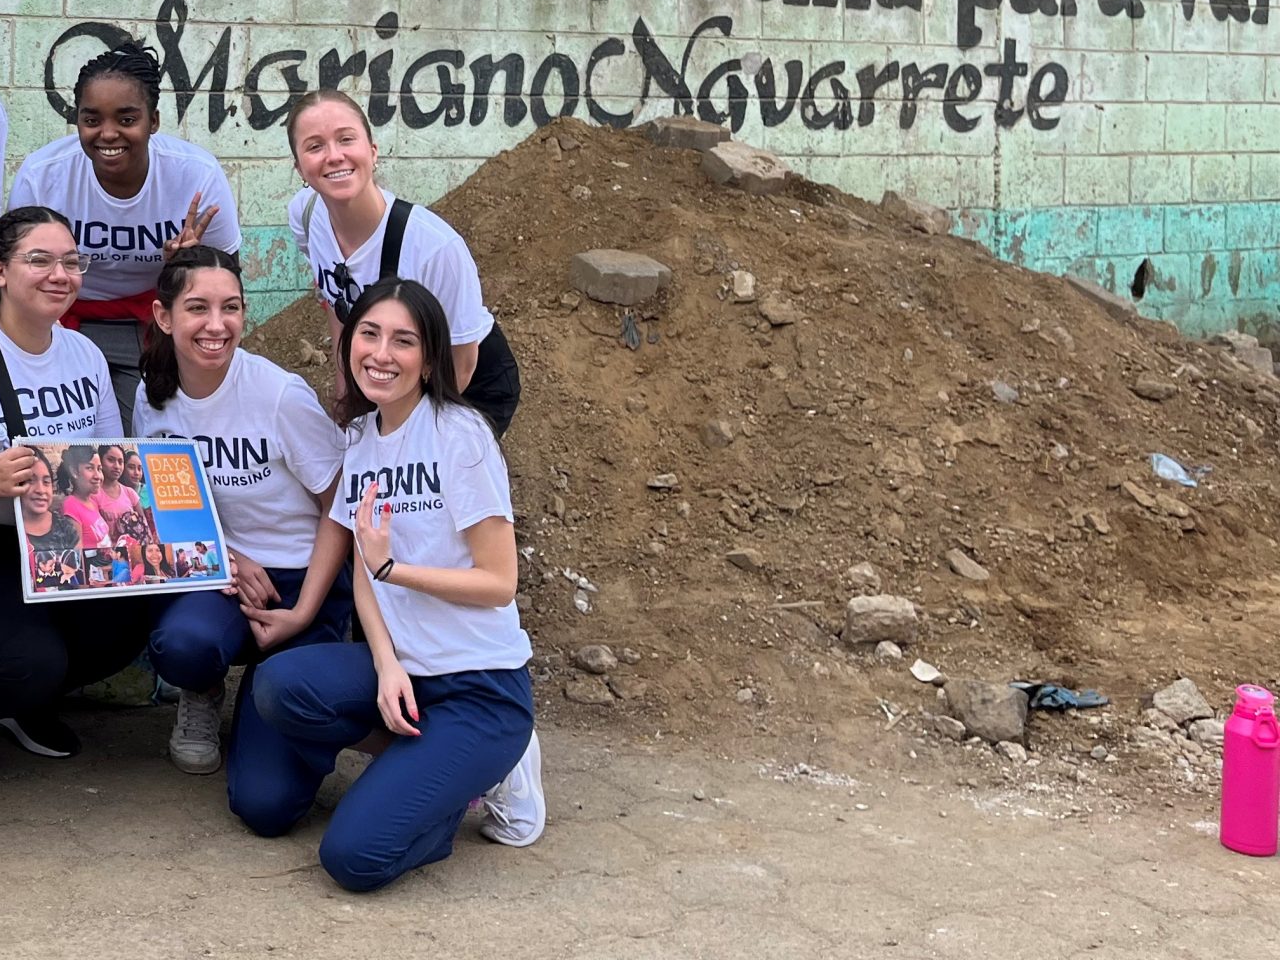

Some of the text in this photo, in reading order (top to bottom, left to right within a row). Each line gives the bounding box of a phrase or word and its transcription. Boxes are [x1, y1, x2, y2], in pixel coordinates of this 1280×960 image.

[586, 15, 1068, 133] Navarrete
[47, 423, 64, 436] OF
[67, 414, 96, 433] NURSI
[147, 433, 269, 470] ONN
[149, 457, 190, 472] DAYS
[153, 473, 176, 483] FOR
[213, 467, 271, 487] NURSING
[156, 484, 197, 498] GIRLS
